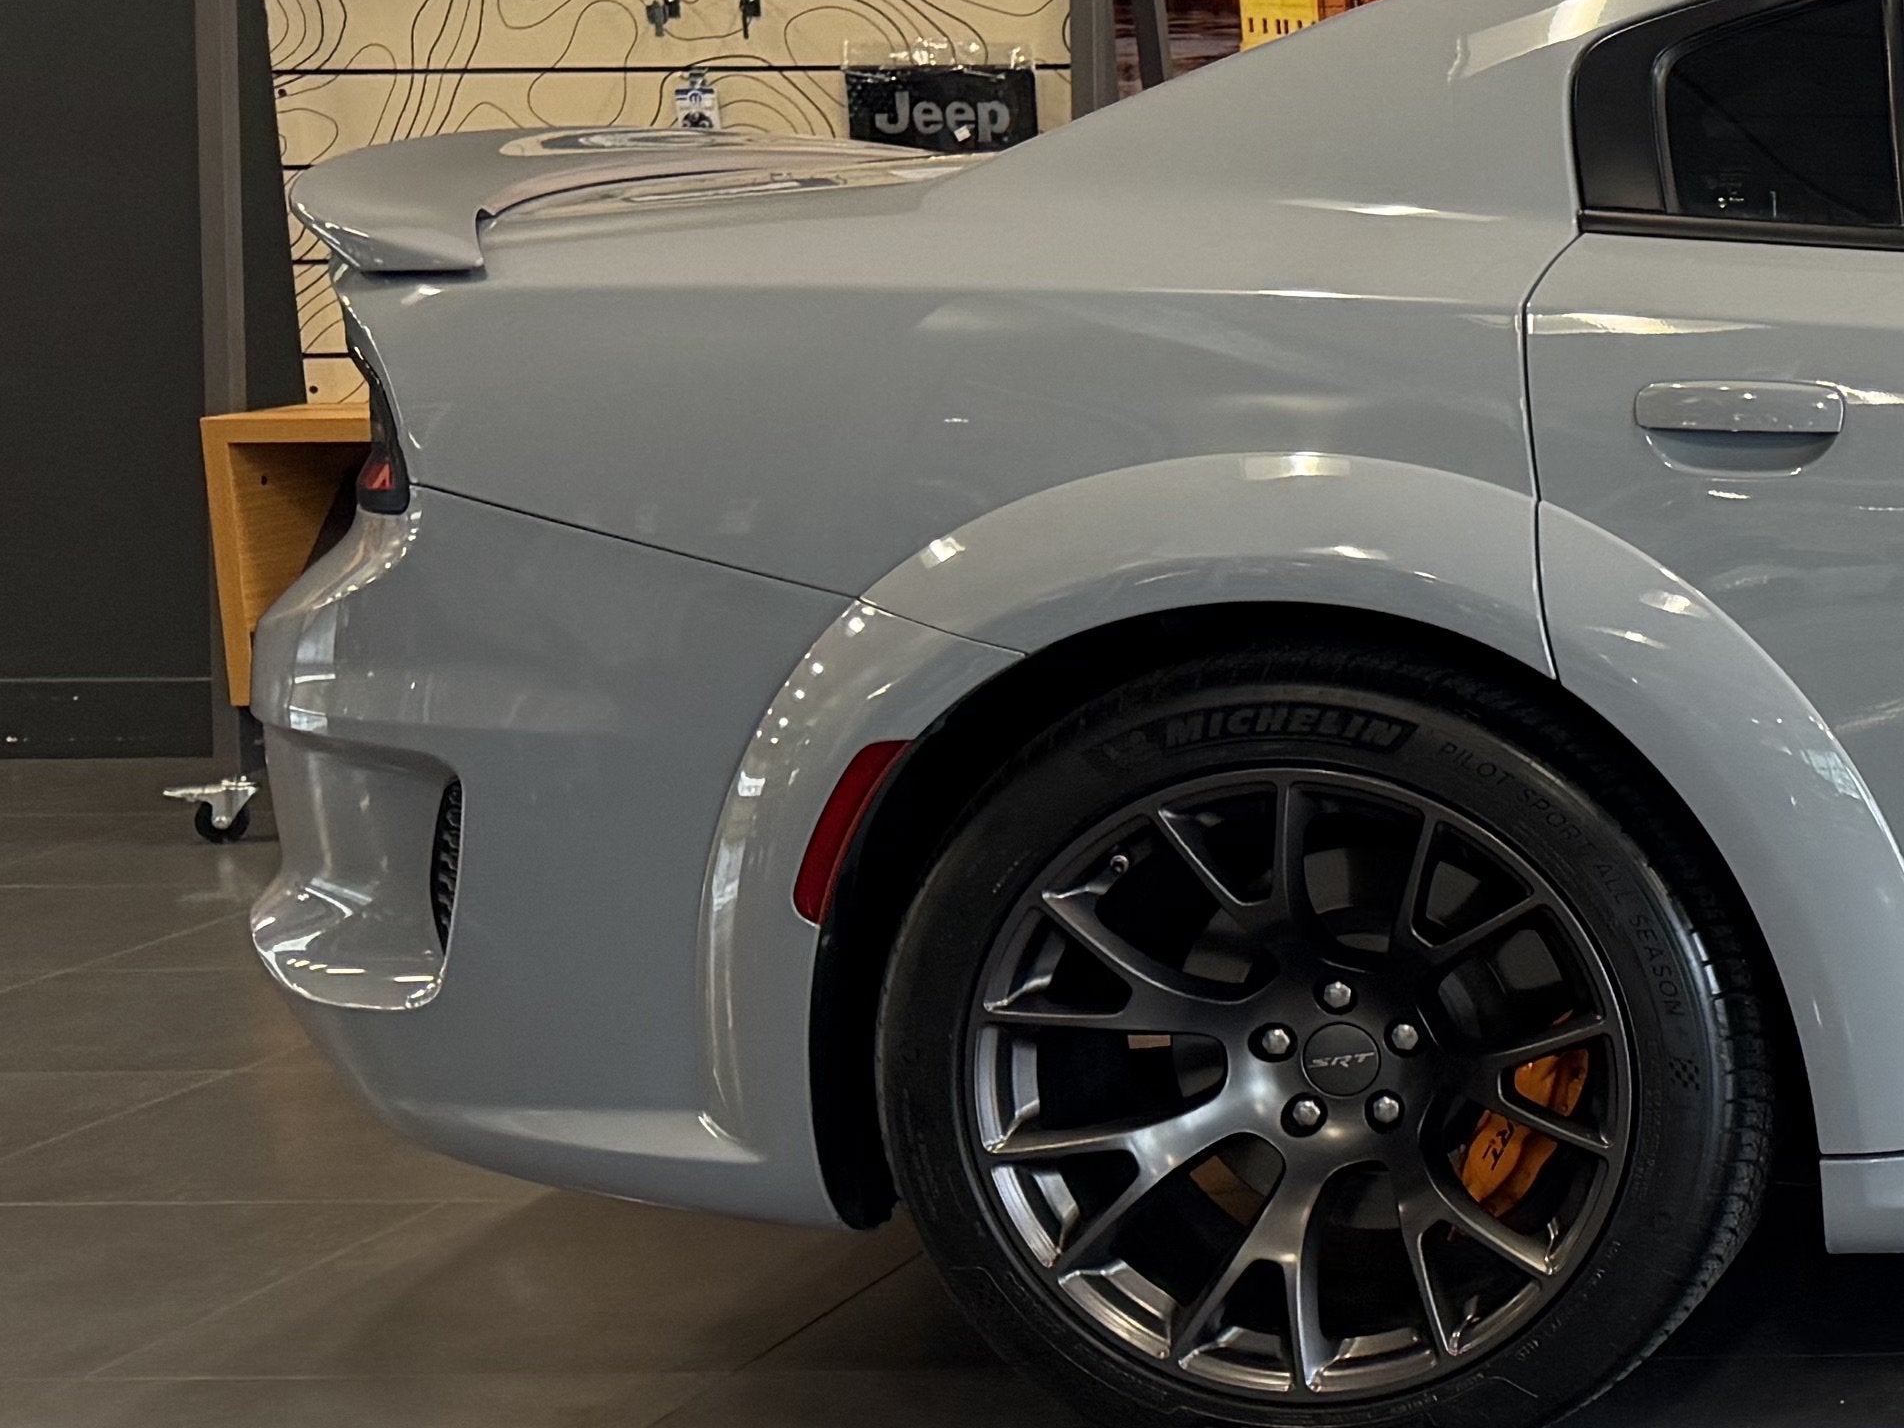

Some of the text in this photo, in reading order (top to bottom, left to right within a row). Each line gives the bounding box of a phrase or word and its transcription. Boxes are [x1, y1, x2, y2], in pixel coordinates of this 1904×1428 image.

[875, 91, 1011, 143] Jeep
[1165, 707, 1403, 748] MICHELIN
[1438, 741, 1686, 1019] PILOT SPORT ALL SEASON
[1308, 1051, 1376, 1069] SRT
